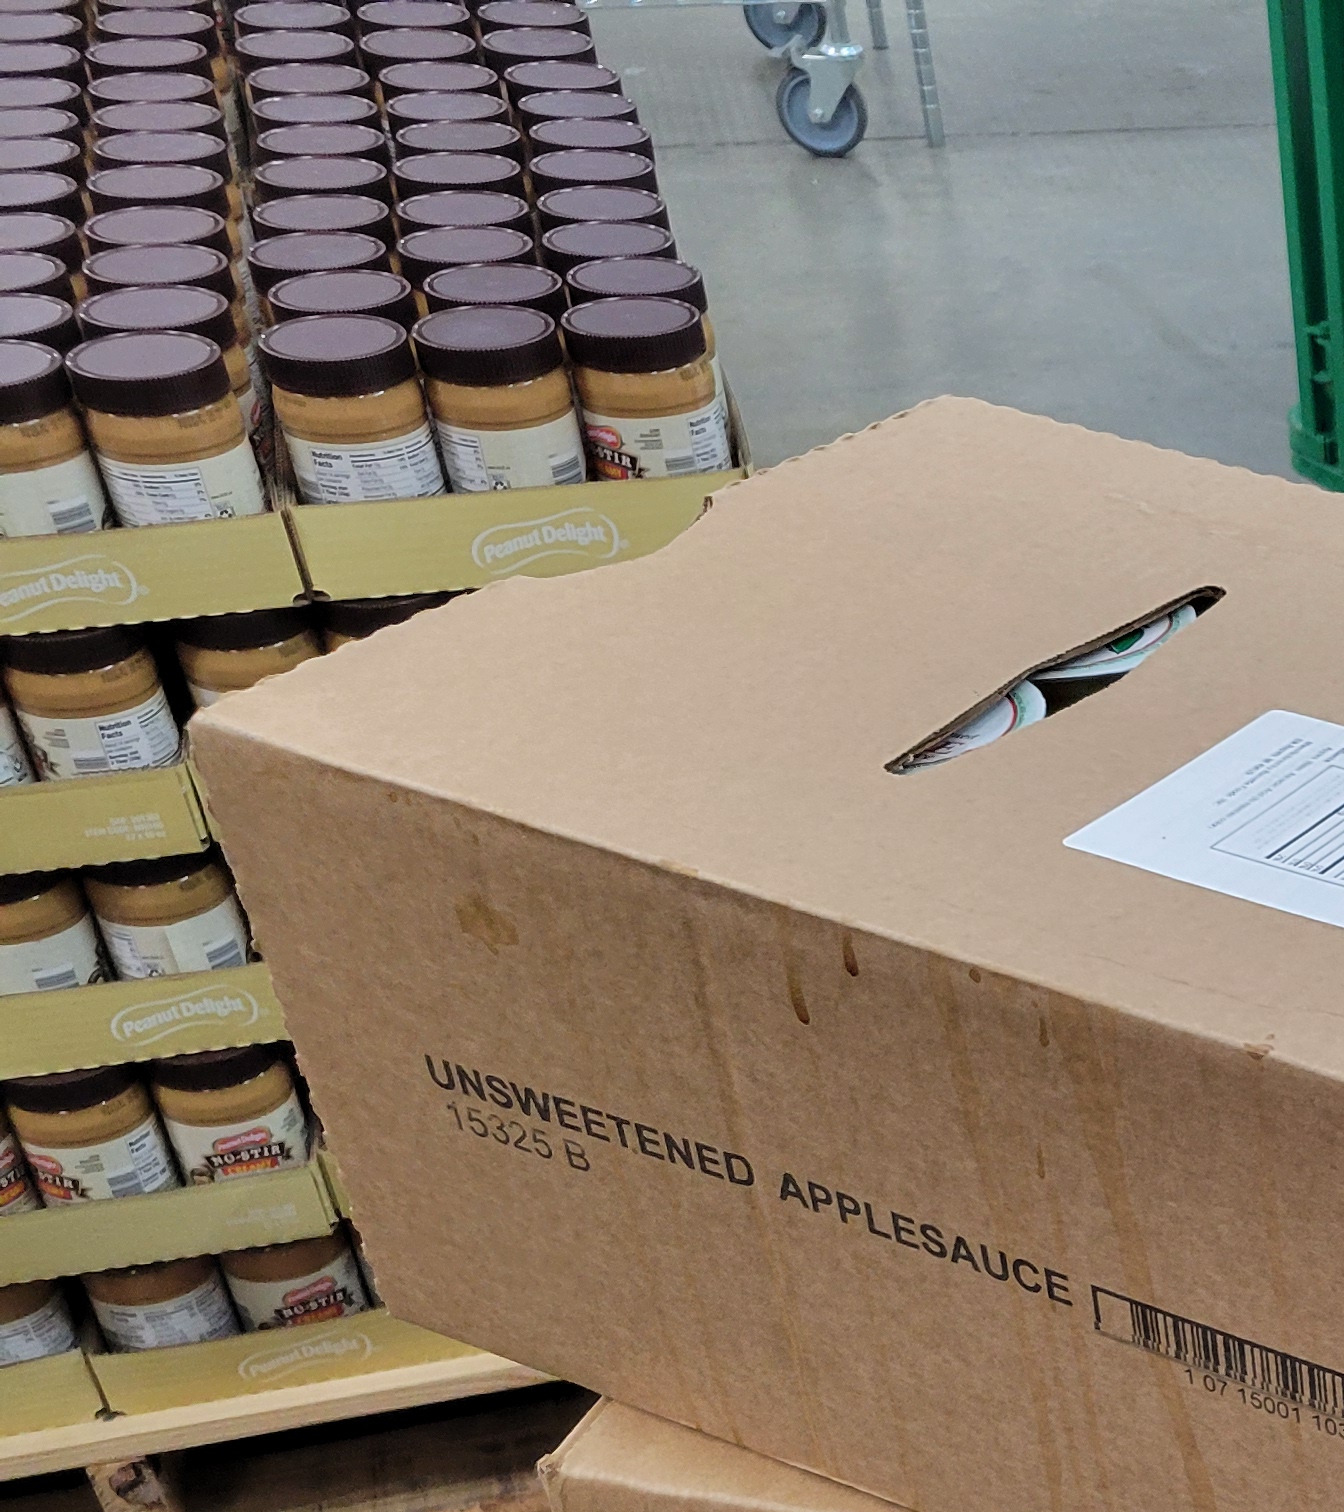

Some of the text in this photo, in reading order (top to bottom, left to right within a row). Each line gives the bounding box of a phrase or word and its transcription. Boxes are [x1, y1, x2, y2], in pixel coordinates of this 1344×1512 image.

[484, 522, 607, 562] Peanut Delight
[50, 569, 124, 594] Delight
[183, 996, 246, 1017] Delight
[446, 1101, 591, 1172] 15325 B
[425, 1055, 1073, 1306] UNSWEETENED APPLESAUCE
[1184, 1369, 1195, 1385] 1
[1204, 1375, 1228, 1396] 07
[1238, 1388, 1300, 1423] 15001
